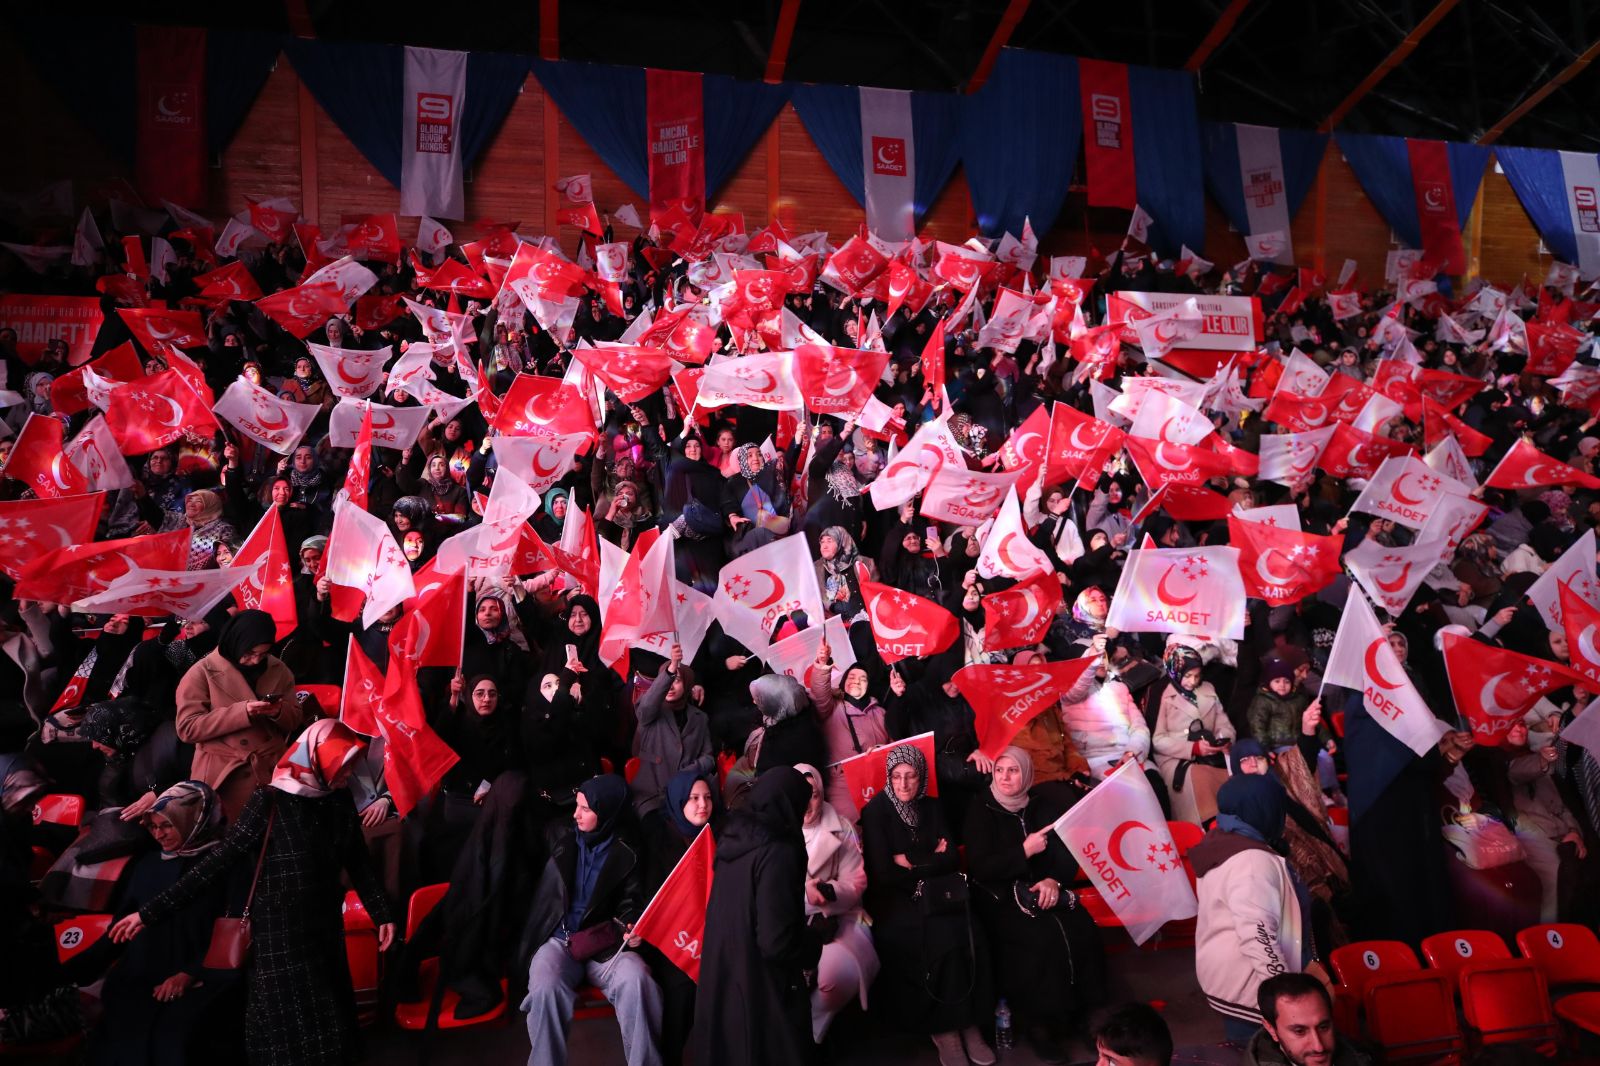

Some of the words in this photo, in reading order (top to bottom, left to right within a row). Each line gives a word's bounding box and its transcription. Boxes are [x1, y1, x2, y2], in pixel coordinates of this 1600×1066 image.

[660, 125, 688, 139] ANCAK
[665, 151, 687, 166] OLUR
[876, 163, 903, 171] SAADET
[1222, 317, 1248, 334] OLUR
[1376, 500, 1429, 523] SAADET
[1146, 610, 1211, 626] SAADET
[1364, 686, 1404, 721] ADET
[1081, 841, 1131, 901] SAADET
[63, 931, 81, 945] 23
[1550, 933, 1559, 945] 4
[1460, 942, 1469, 955] 5
[1366, 953, 1376, 967] 6
